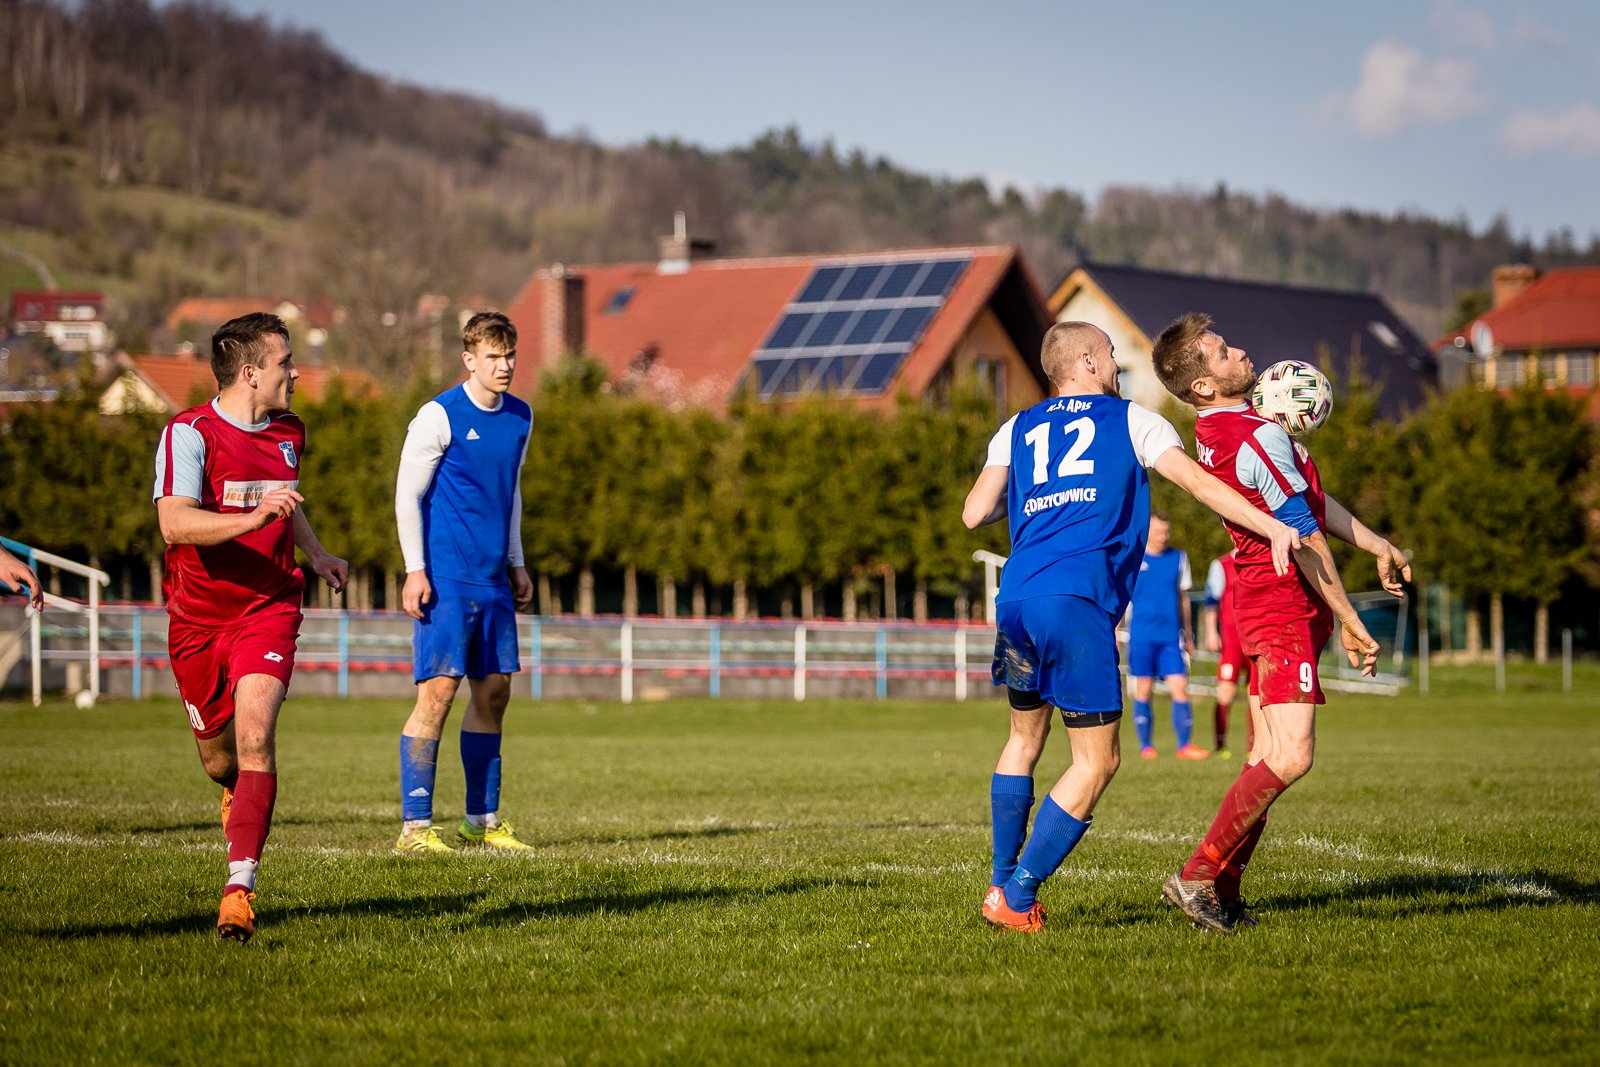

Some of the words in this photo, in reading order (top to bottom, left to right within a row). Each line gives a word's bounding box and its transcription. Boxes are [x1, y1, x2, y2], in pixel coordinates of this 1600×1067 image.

[1066, 398, 1093, 413] APIS
[1024, 416, 1096, 485] 12
[224, 492, 264, 501] JELENIA
[1023, 488, 1097, 516] ĘDRZYCHOWICE
[1299, 661, 1313, 693] 9
[184, 699, 206, 731] 10
